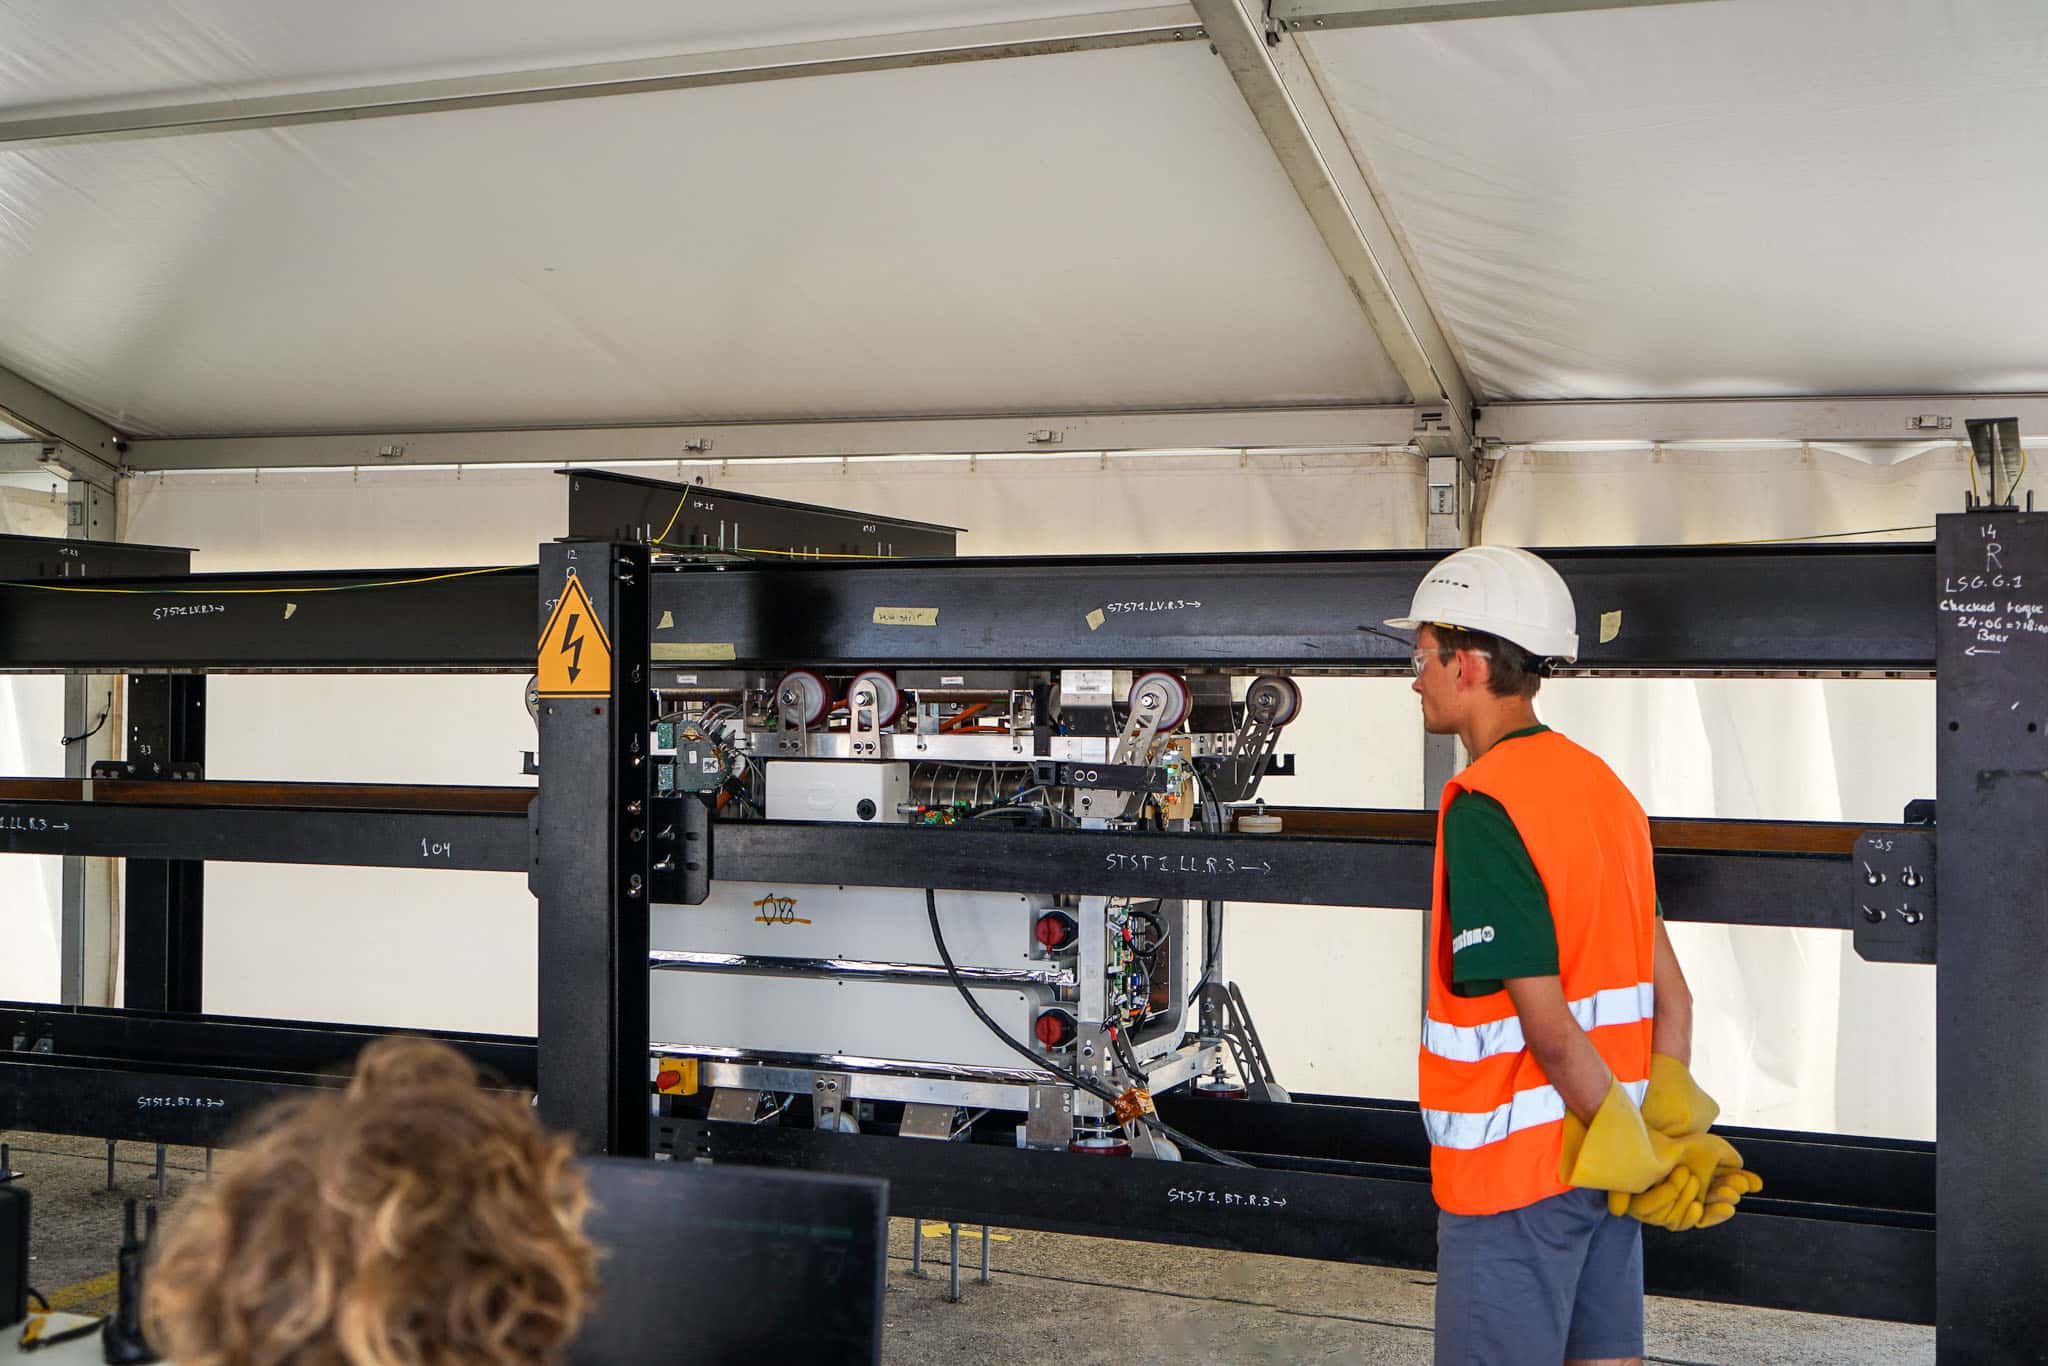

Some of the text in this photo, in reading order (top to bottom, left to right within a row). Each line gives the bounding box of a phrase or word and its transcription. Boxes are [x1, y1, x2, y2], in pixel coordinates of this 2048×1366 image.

[1981, 523, 1997, 539] 14
[567, 549, 578, 560] 12
[1986, 543, 2002, 572] R
[421, 837, 451, 858] 104
